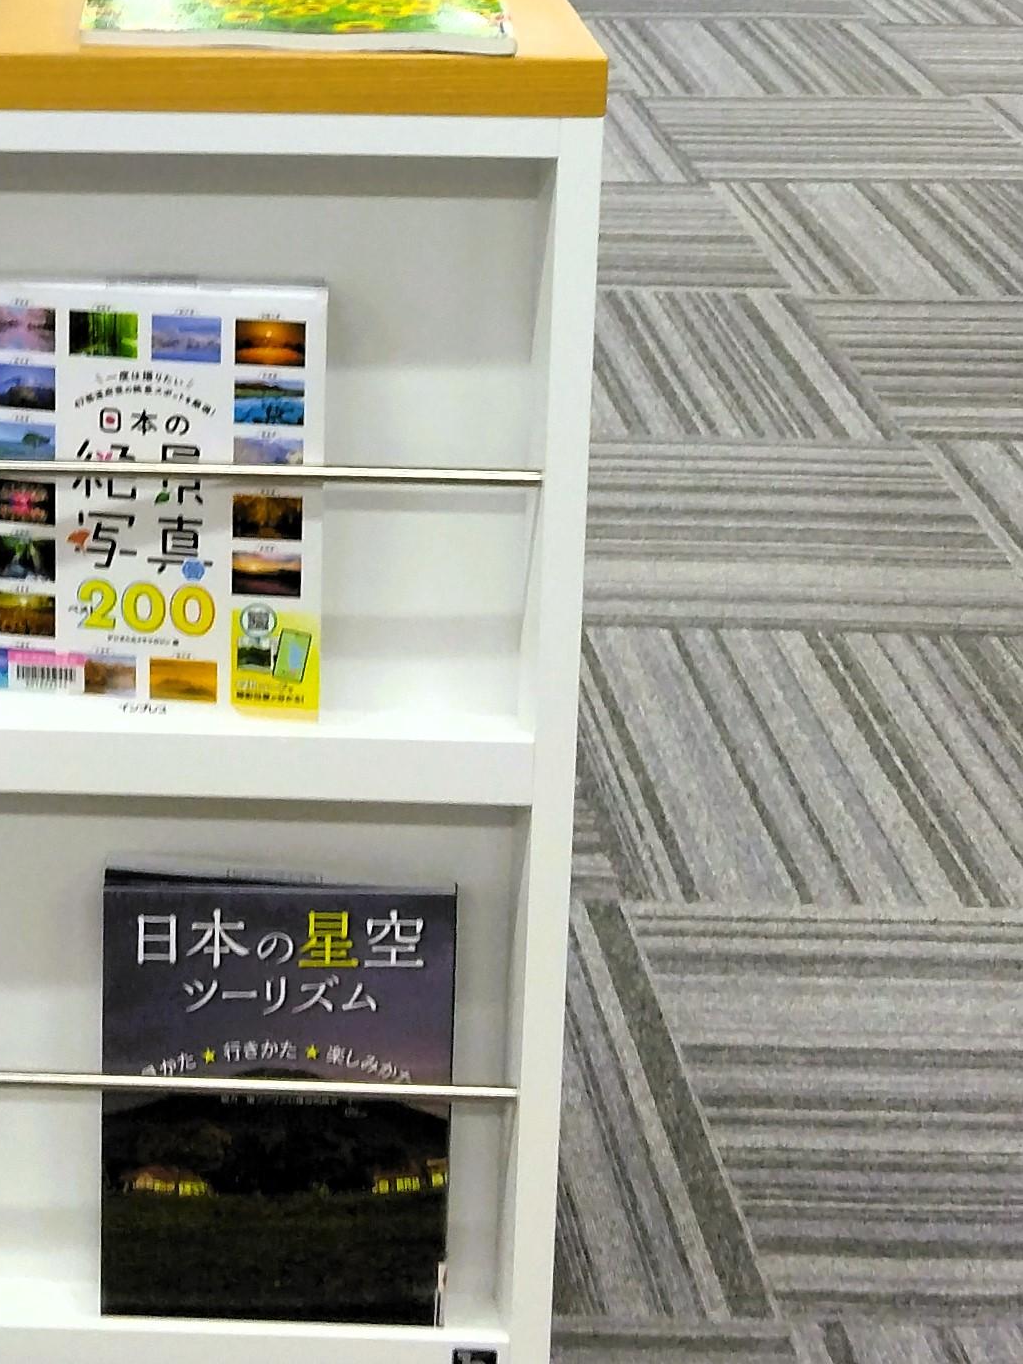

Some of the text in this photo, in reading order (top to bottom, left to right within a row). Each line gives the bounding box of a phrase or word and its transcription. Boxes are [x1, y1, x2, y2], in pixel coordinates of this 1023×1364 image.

[99, 406, 190, 436] 日本の
[77, 509, 214, 574] 写真
[76, 578, 216, 637] 200
[137, 907, 424, 969] 日本の星空
[183, 974, 377, 1016] ツーリズム
[224, 1038, 297, 1063] 行きかた
